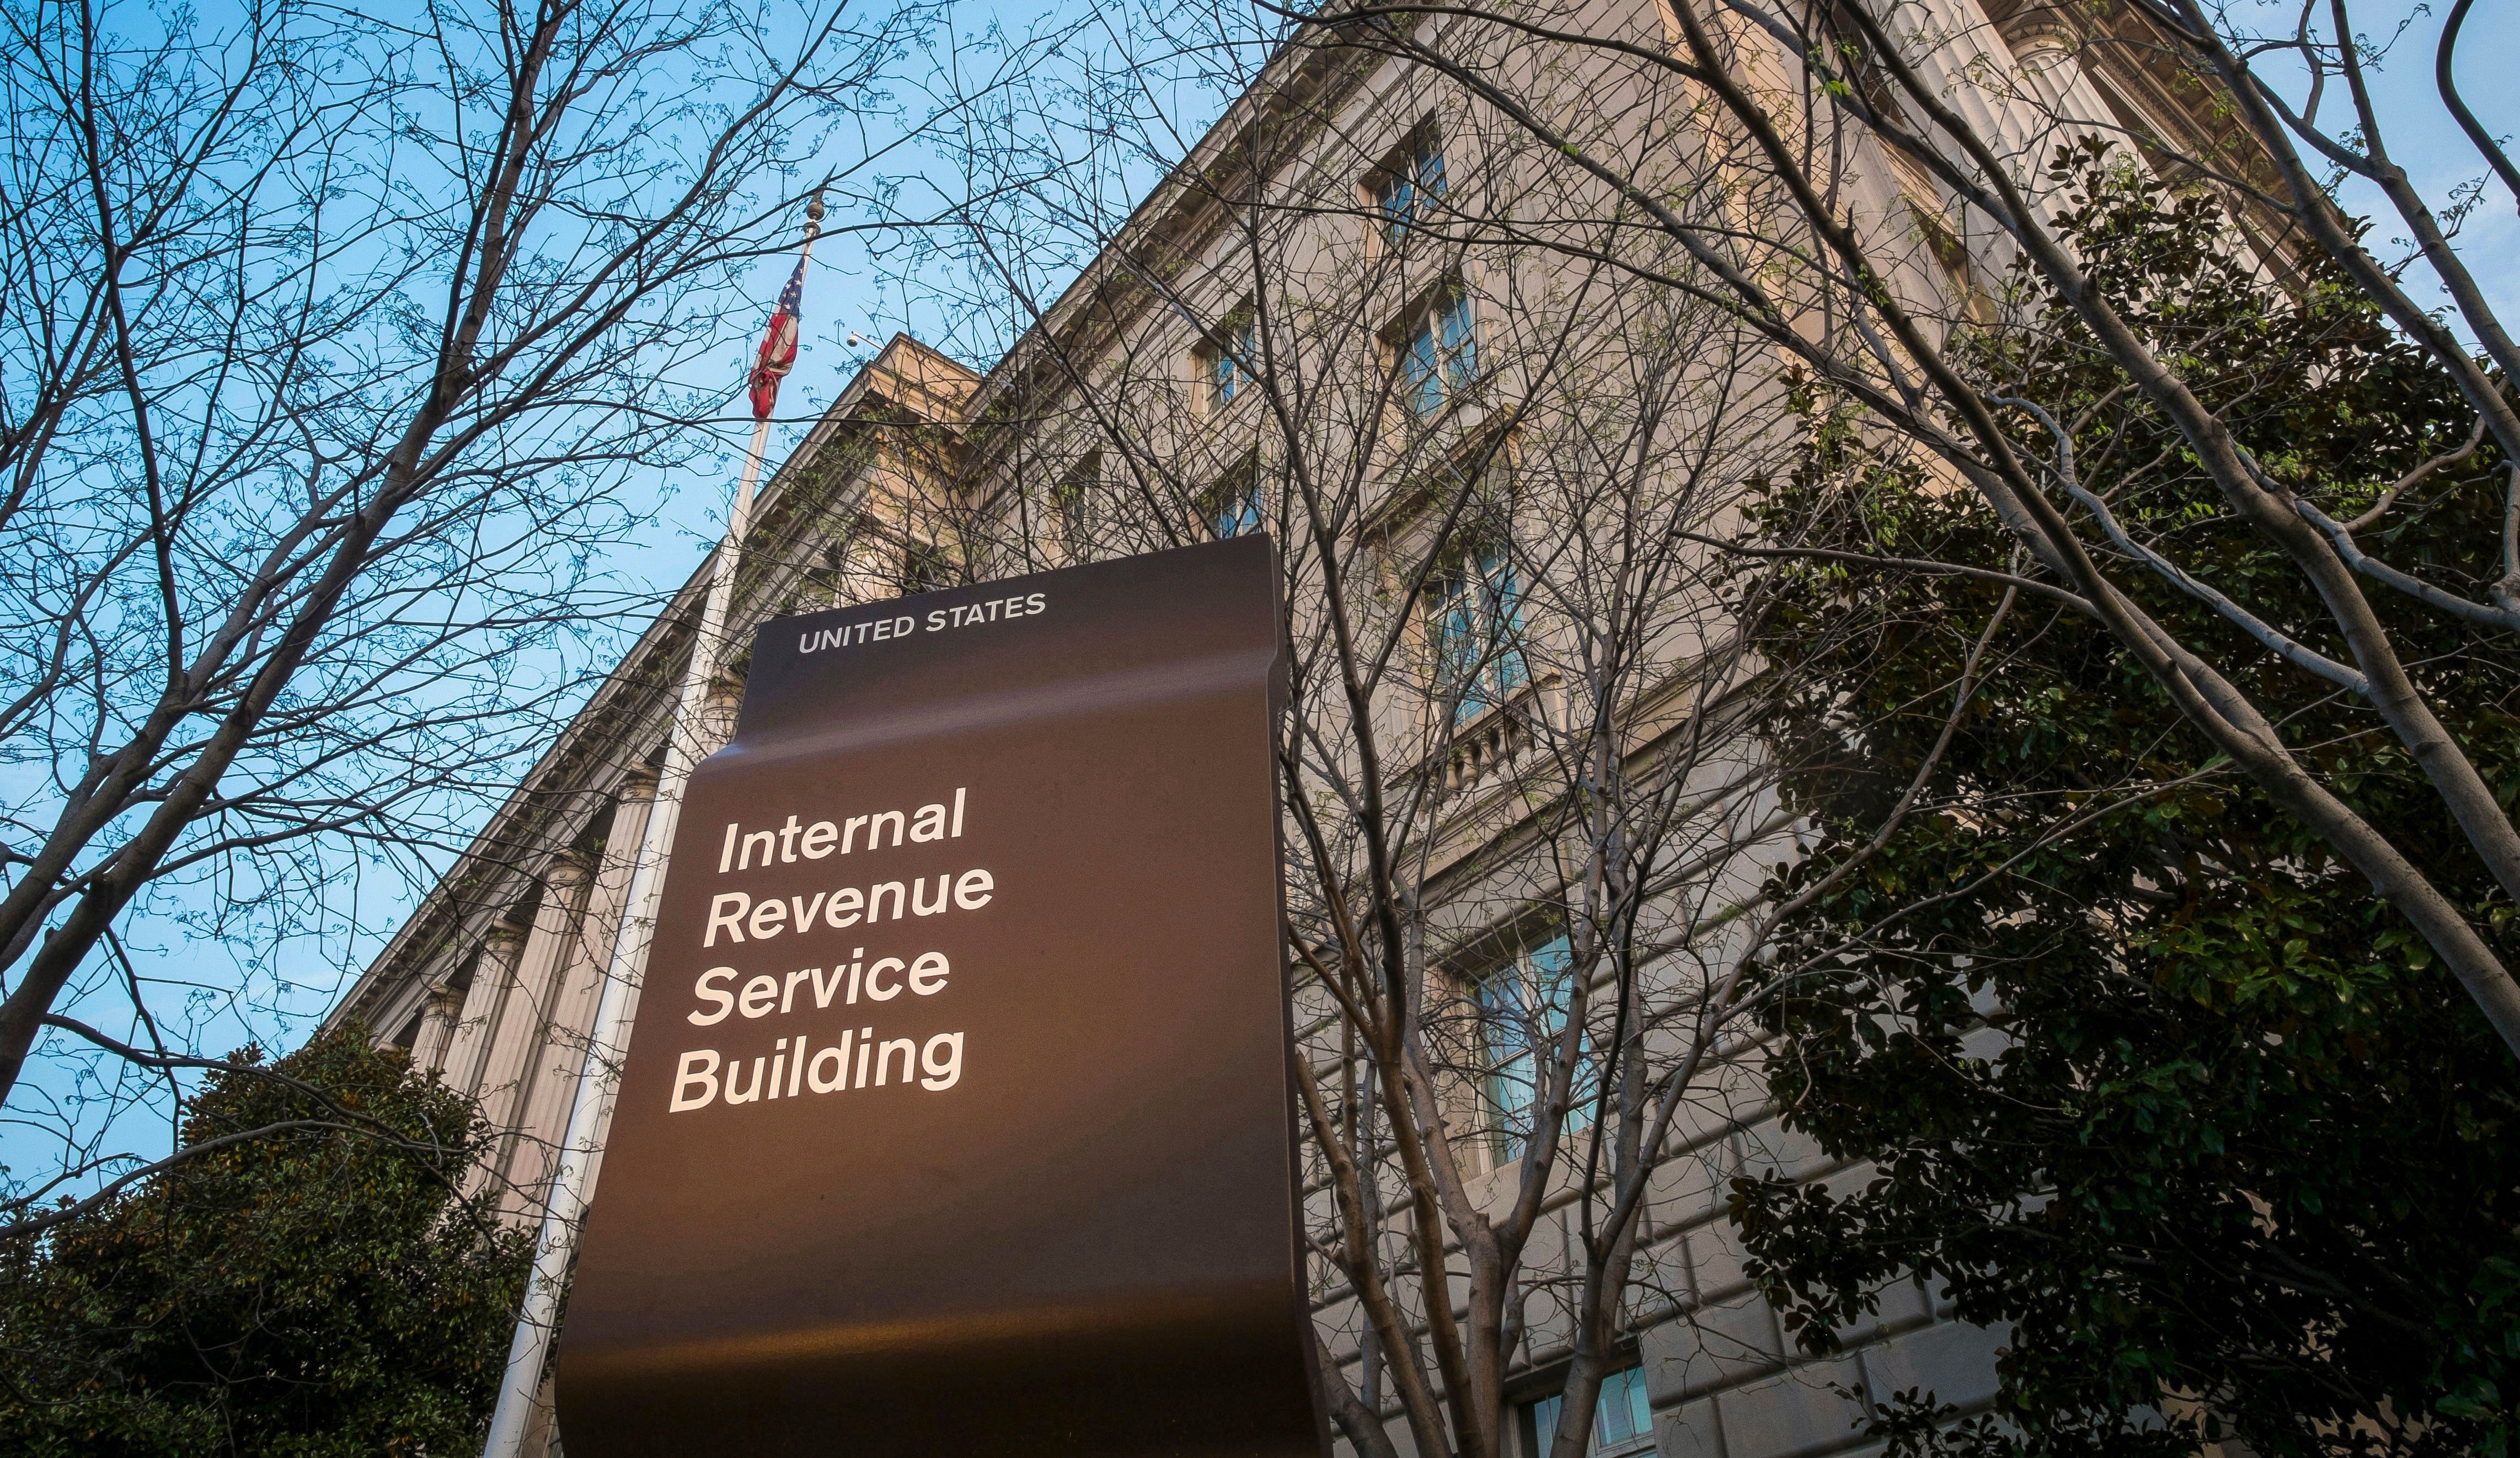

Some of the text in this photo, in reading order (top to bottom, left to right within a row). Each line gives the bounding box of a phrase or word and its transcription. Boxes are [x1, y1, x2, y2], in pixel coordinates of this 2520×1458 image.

[799, 593, 1046, 654] UNITED STATES
[718, 787, 966, 874] Internal
[703, 868, 994, 948] Revenue
[687, 947, 950, 1026] Service
[669, 1027, 965, 1113] Building
